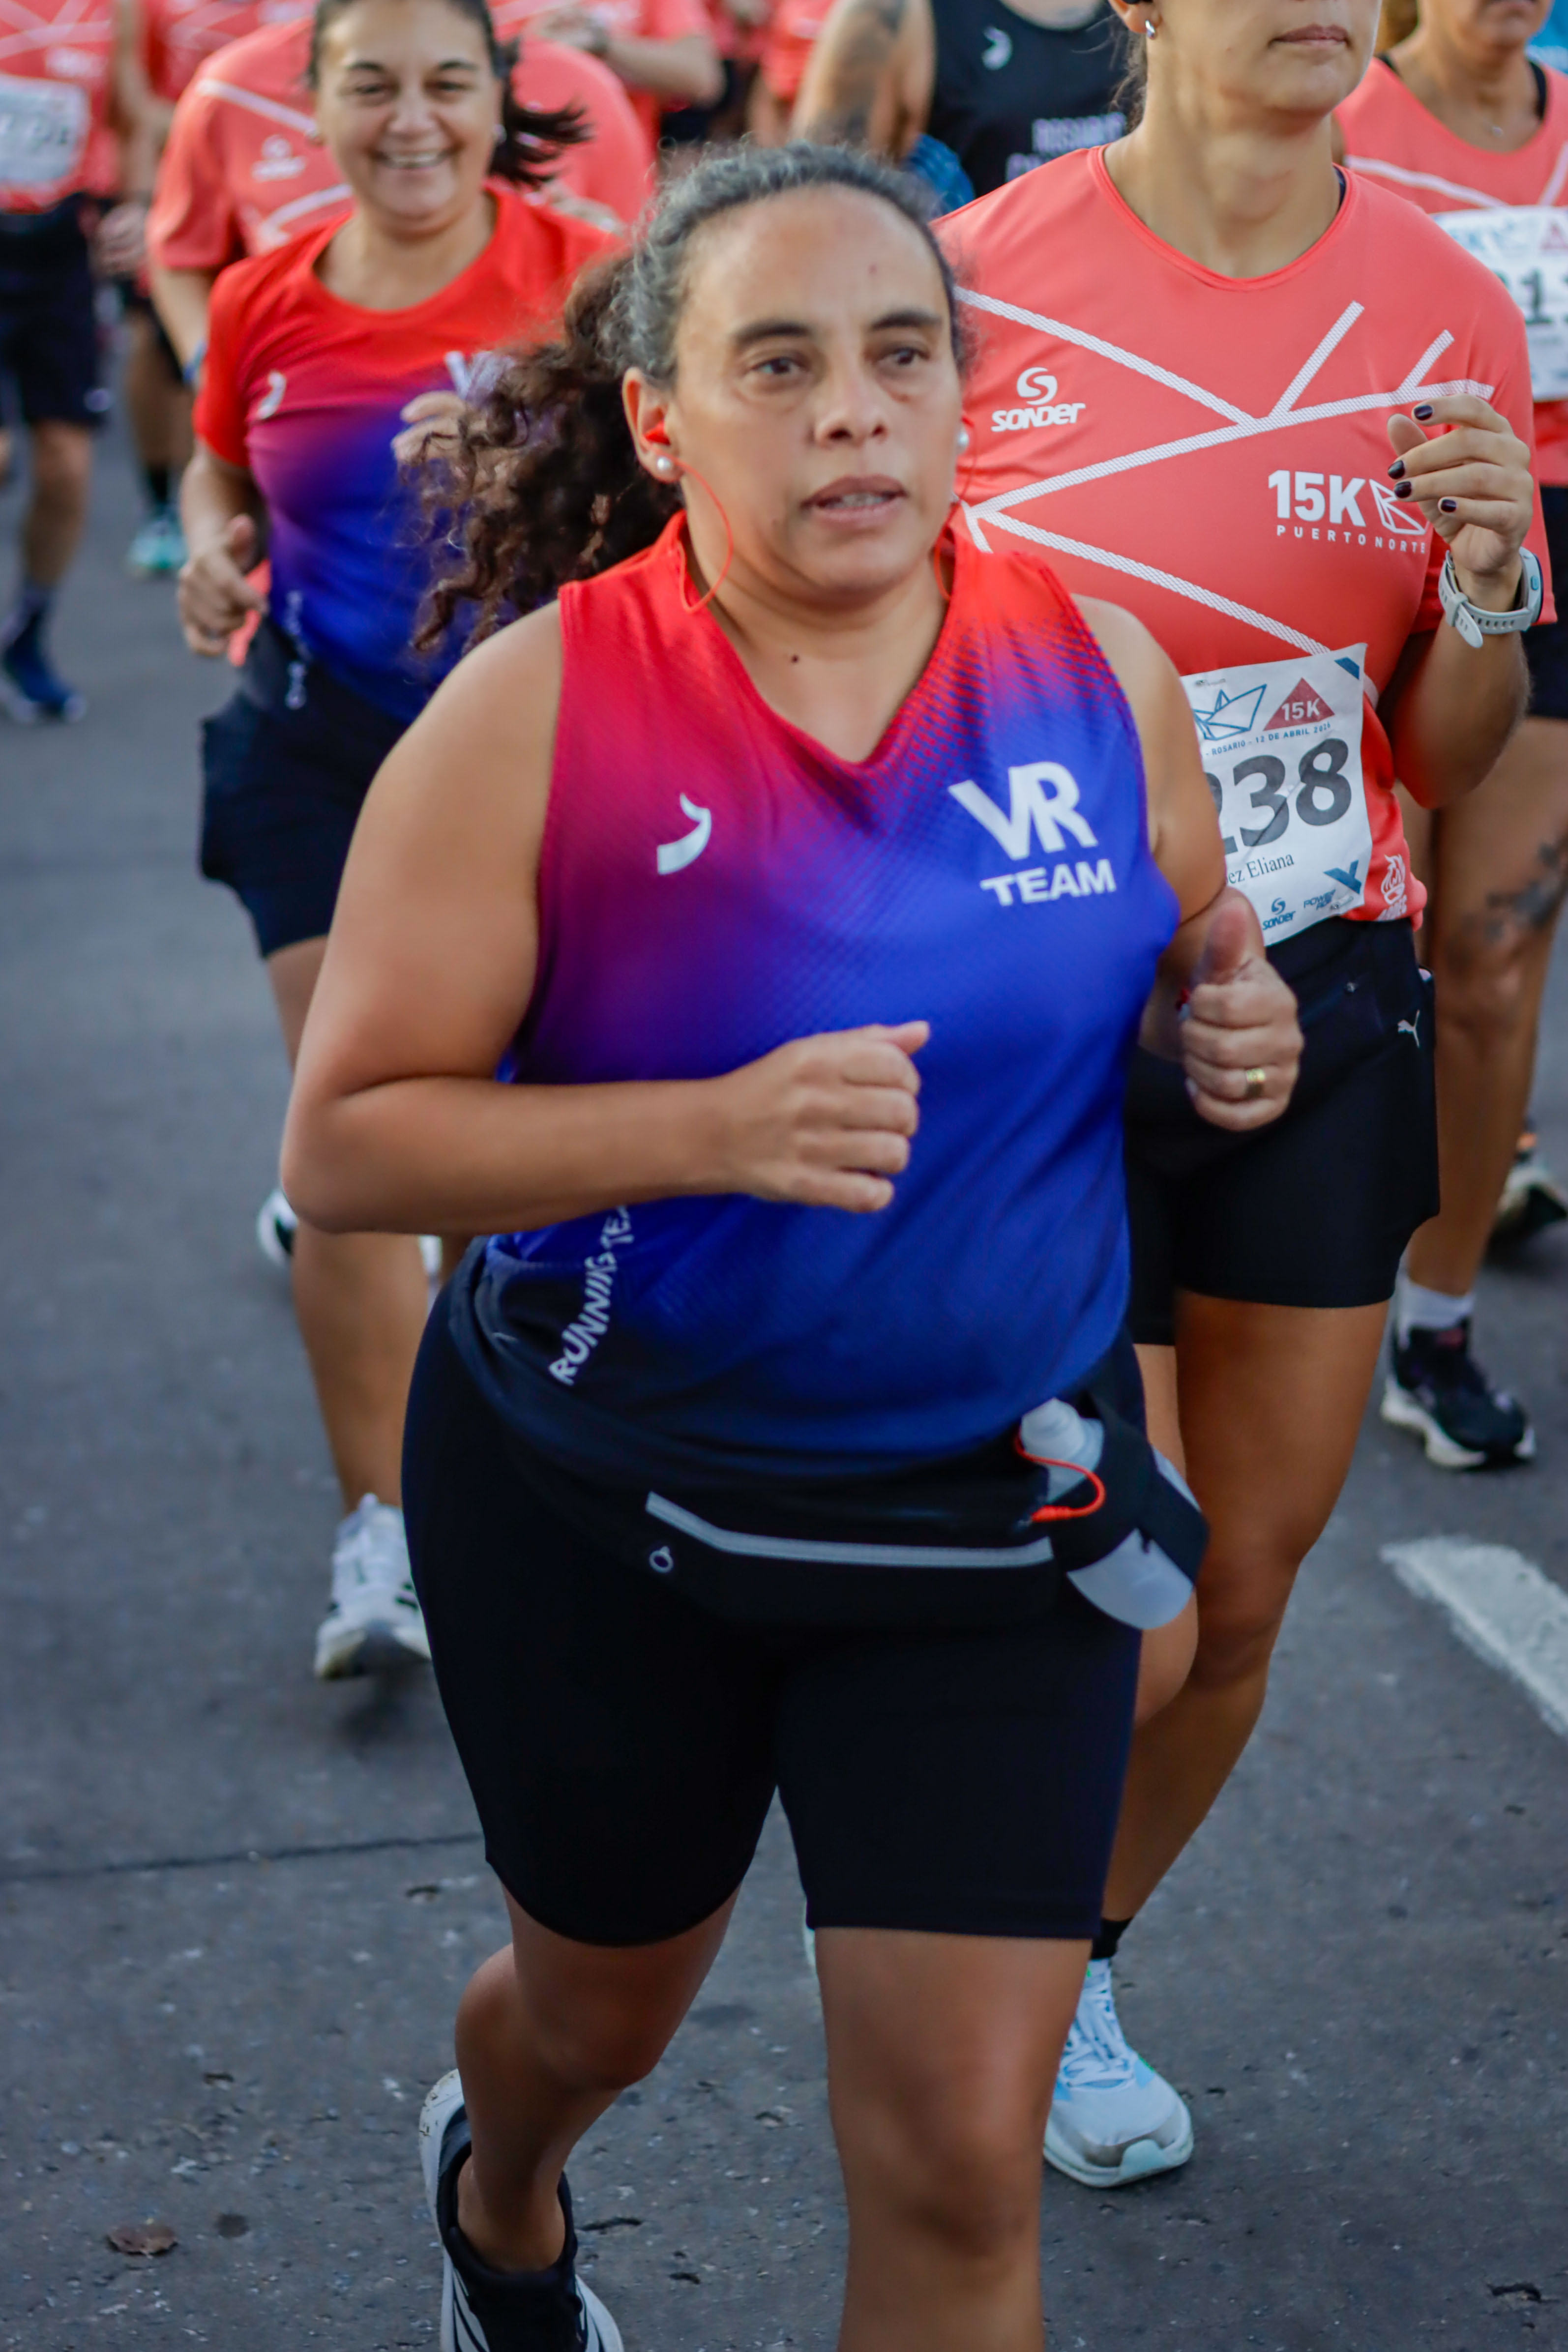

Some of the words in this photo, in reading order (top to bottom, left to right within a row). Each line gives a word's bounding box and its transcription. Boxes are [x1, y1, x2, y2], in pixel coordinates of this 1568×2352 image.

[1268, 469, 1366, 528] 15K
[1276, 525, 1366, 546] PUERTO
[1375, 536, 1425, 554] NORTE
[1281, 698, 1321, 721] 15K
[1211, 739, 1246, 756] ROSARIO
[1255, 735, 1265, 743] 12
[1268, 733, 1279, 741] DE
[1283, 728, 1310, 738] ABRIL
[947, 761, 1098, 861] VR
[979, 858, 1117, 907] TEAM
[1246, 853, 1295, 879] Eliana
[548, 1251, 618, 1387] RUNNING
